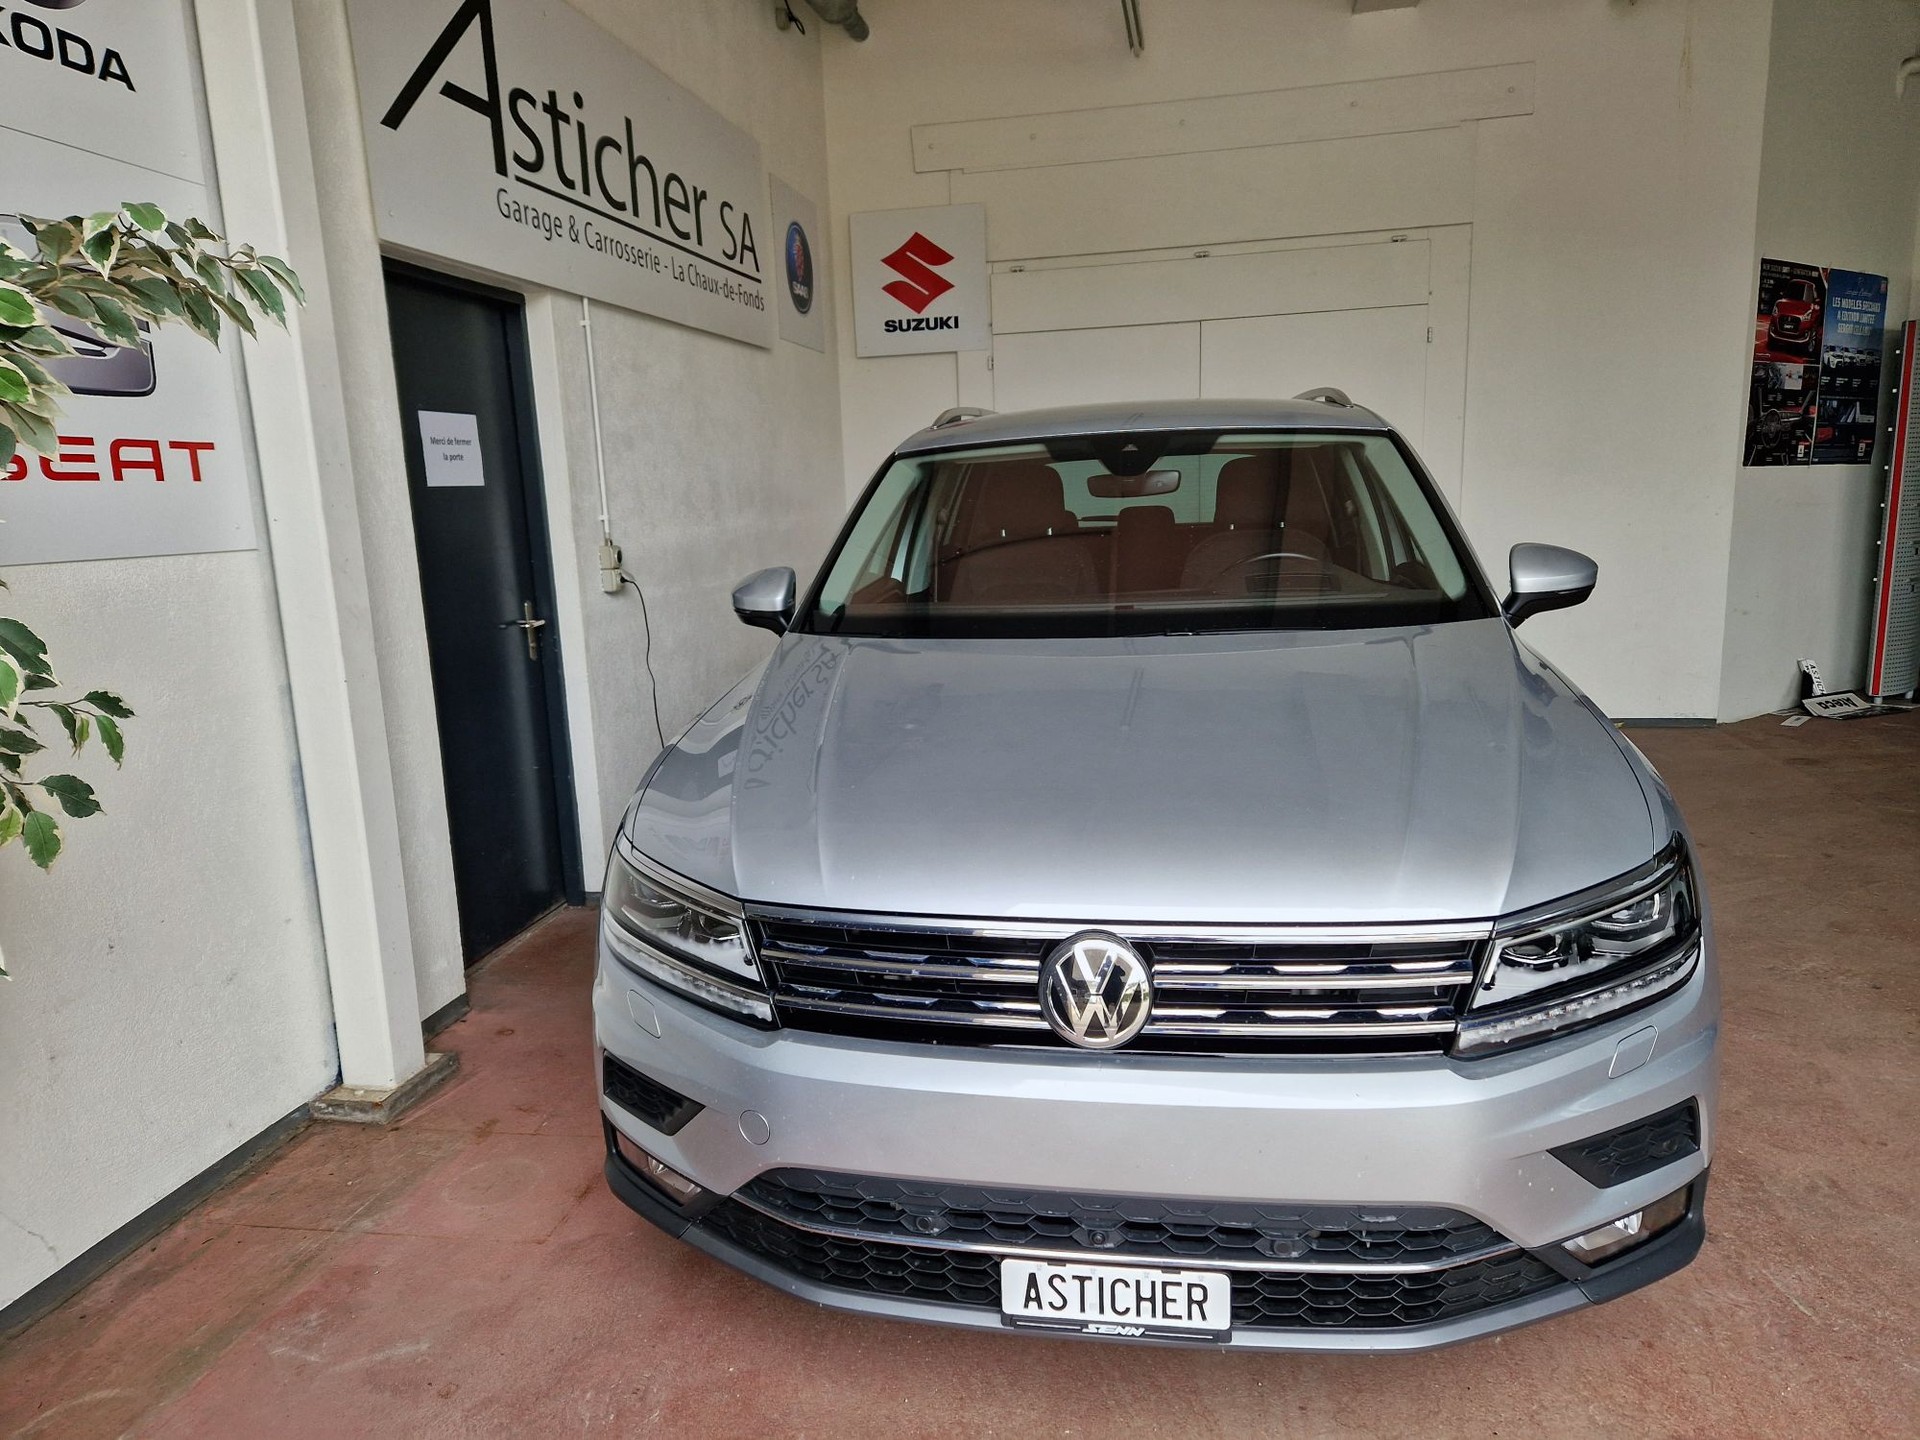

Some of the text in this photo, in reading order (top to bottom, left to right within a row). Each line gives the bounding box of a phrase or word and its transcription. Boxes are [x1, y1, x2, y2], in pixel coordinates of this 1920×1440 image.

[380, 0, 760, 272] Asticher SA
[496, 187, 563, 240] Garage
[568, 214, 580, 244] &
[584, 221, 661, 273] Carrosserie
[671, 256, 685, 282] La
[687, 263, 765, 312] Chaux-de-Fonds
[884, 316, 960, 333] SUZUKI
[430, 436, 472, 446] Merci de fermer
[443, 453, 464, 463] la porte
[1816, 697, 1858, 710] Ateca
[1023, 1272, 1208, 1322] ASTICHER
[1082, 1323, 1146, 1338] SENN
